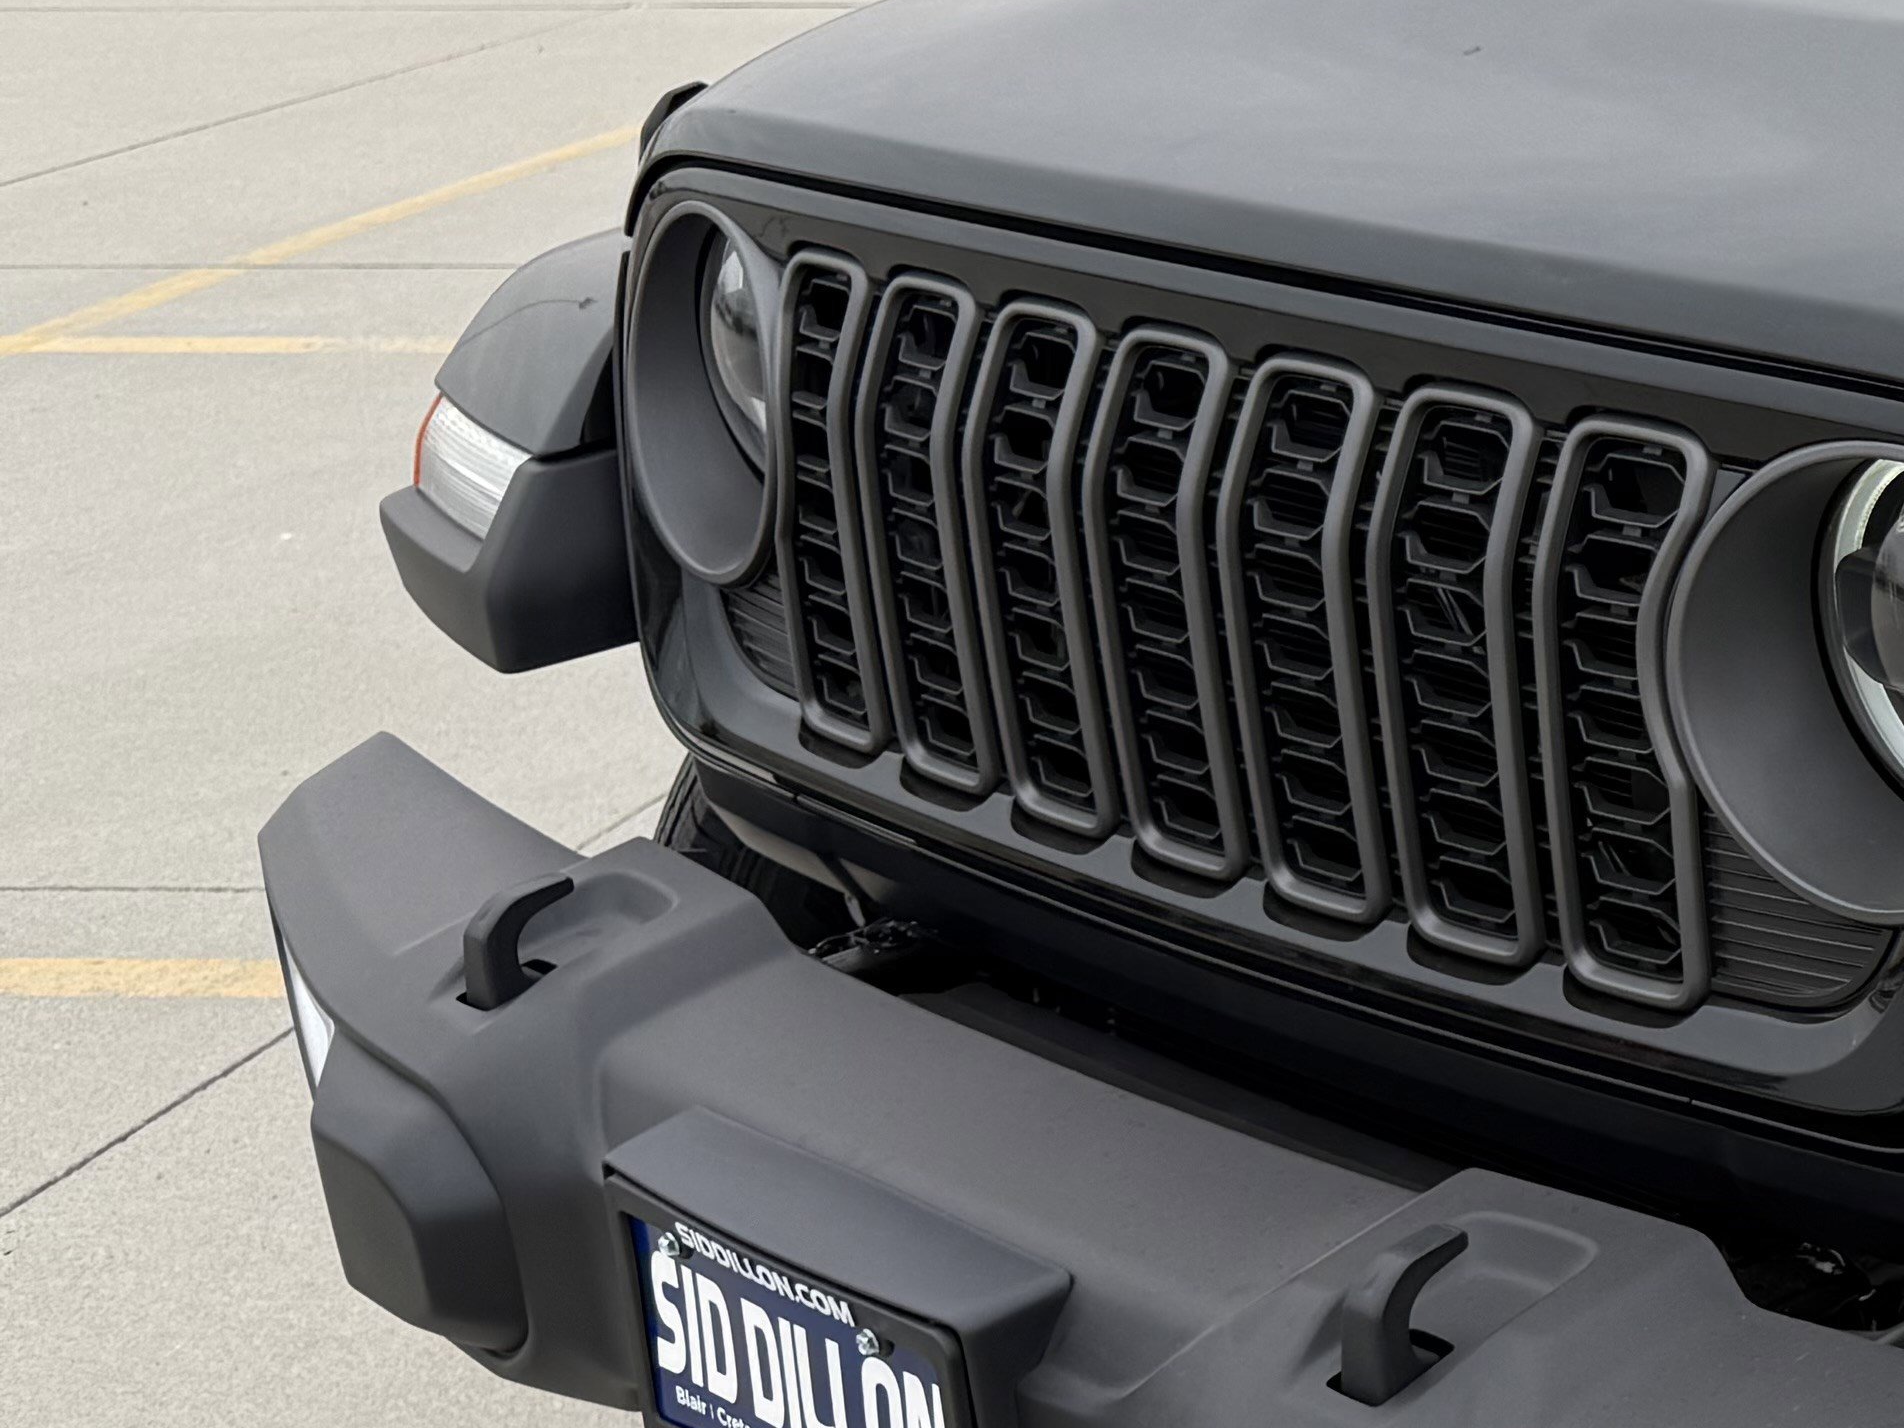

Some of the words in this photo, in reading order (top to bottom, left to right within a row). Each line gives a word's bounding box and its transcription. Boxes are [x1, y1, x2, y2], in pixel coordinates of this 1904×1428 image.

[651, 1249, 738, 1404] SID
[674, 1222, 857, 1327] SIDDILLON.COM
[675, 1385, 708, 1417] Blair
